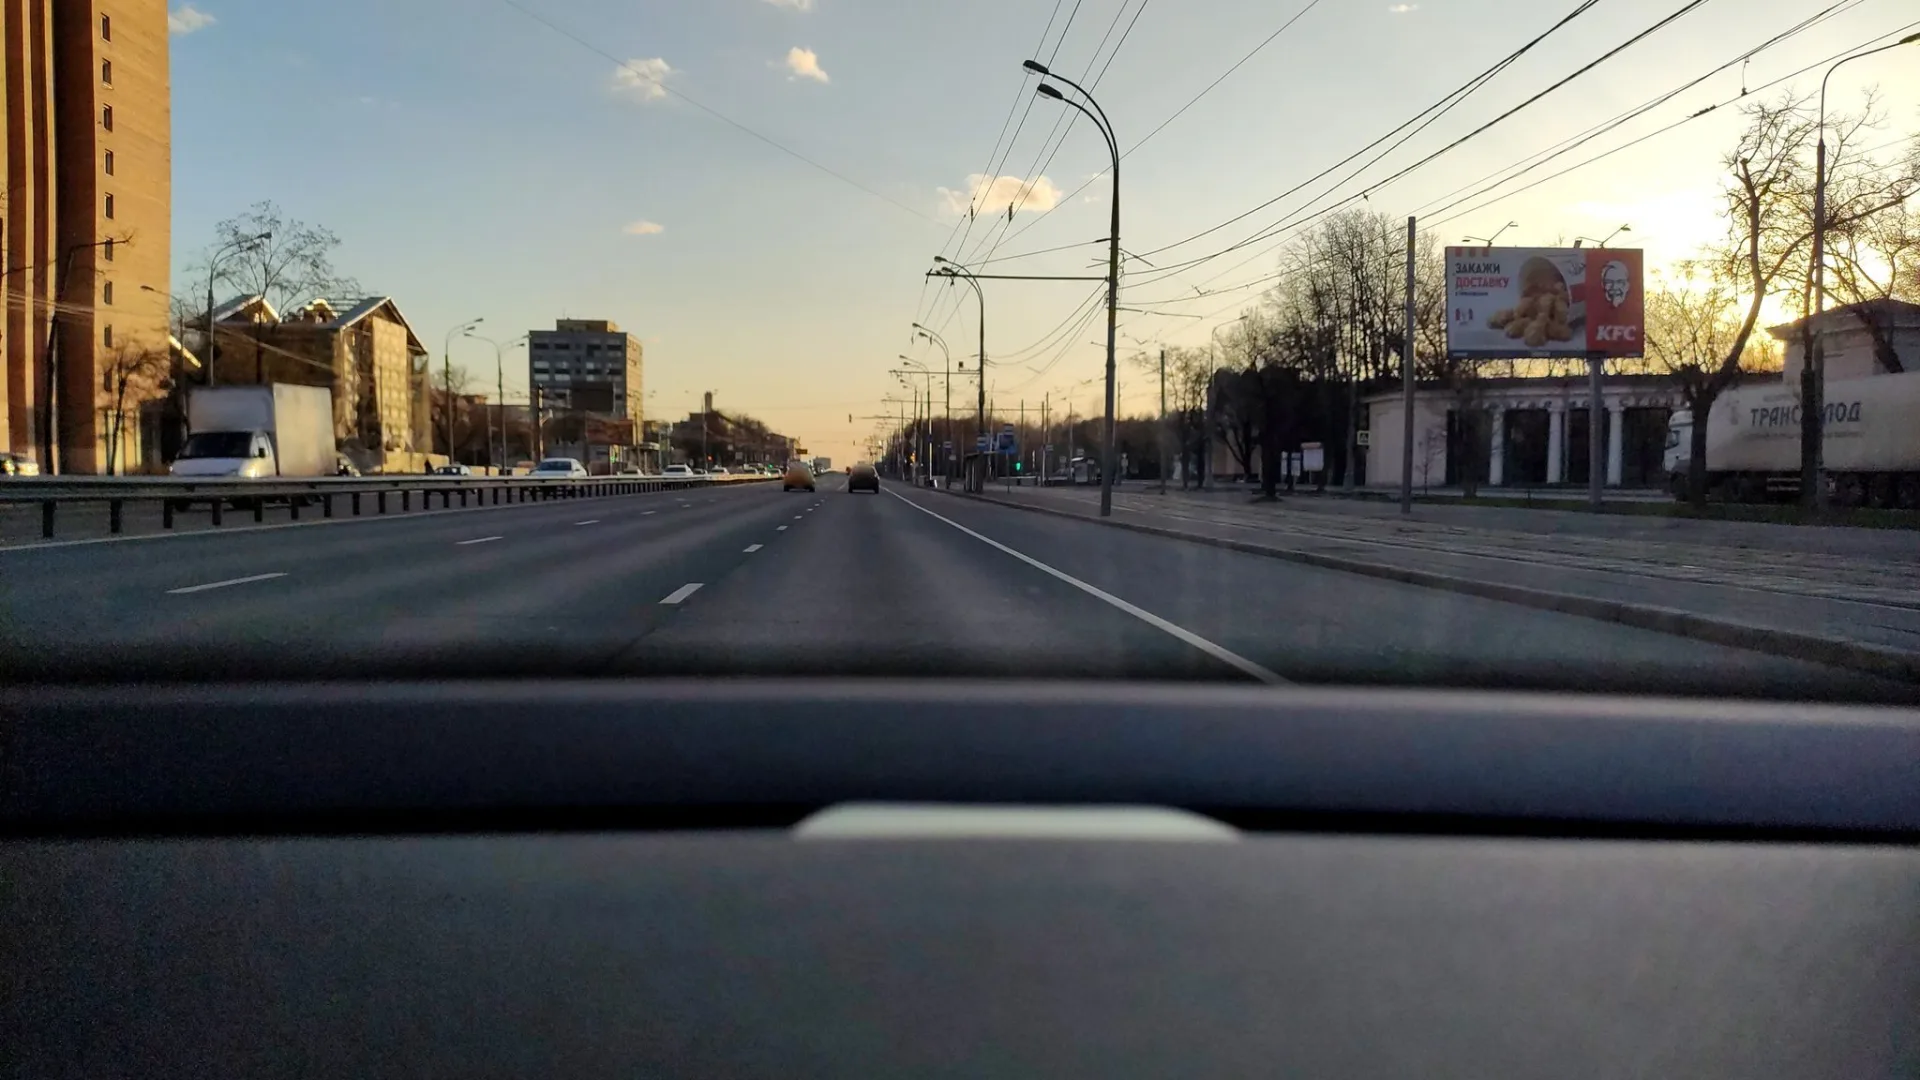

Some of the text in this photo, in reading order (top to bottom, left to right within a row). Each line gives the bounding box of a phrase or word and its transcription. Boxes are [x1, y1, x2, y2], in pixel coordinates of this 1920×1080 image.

[1455, 262, 1500, 274] ЗАКАЖИ
[1455, 276, 1509, 289] ДОСТАВКУ
[1596, 325, 1637, 341] KFC
[1751, 401, 1862, 427] ТРАНСЛОД
